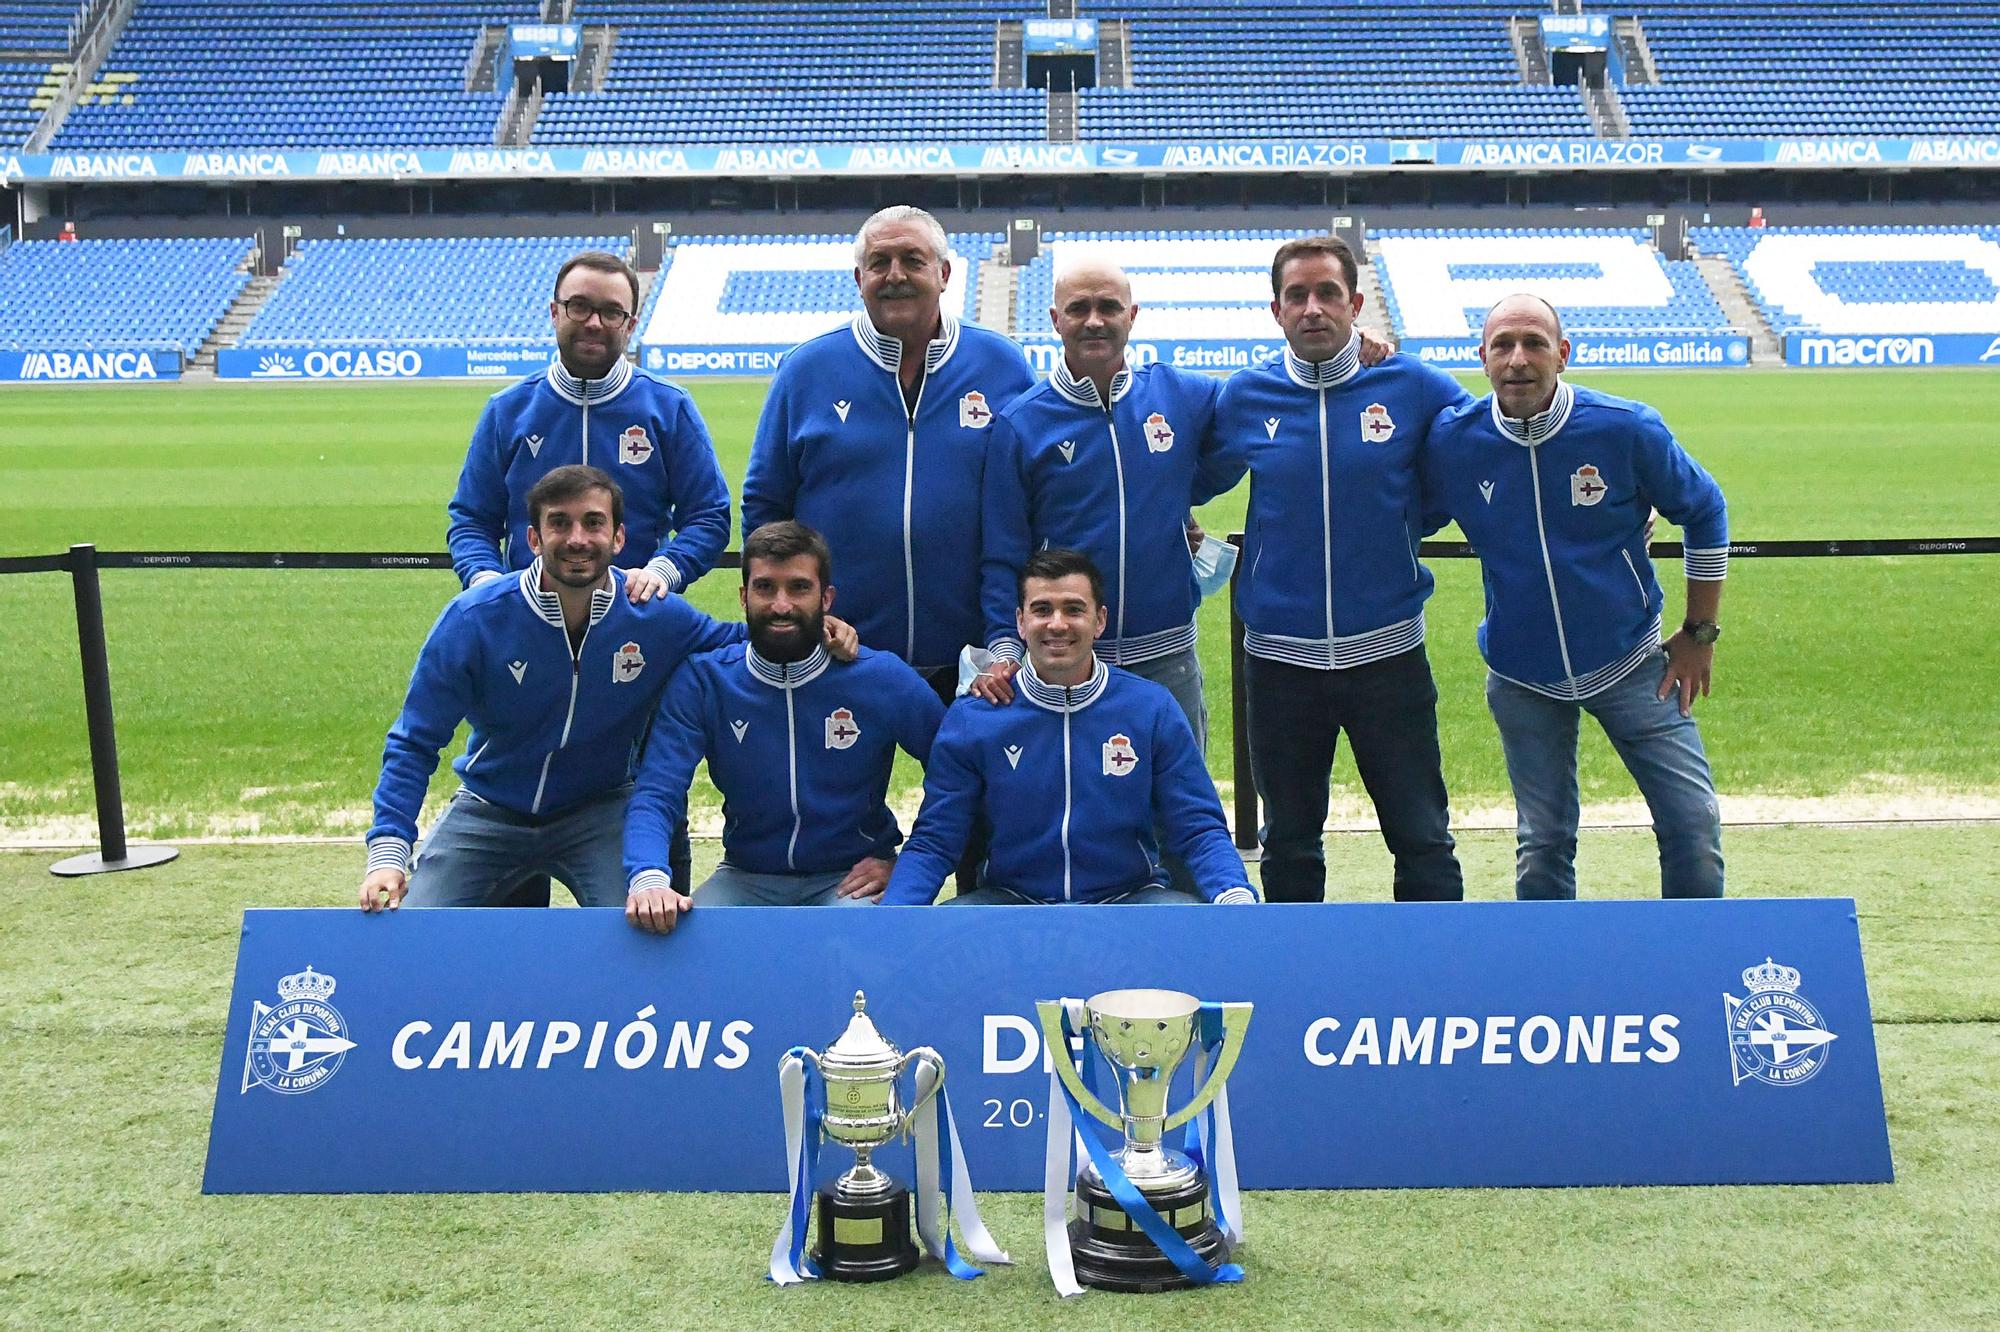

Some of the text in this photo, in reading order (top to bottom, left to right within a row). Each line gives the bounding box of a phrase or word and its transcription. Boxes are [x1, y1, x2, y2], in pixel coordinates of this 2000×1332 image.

[459, 151, 555, 172] ABANCA
[592, 150, 688, 171] ABANCA
[725, 149, 821, 170] ABANCA
[858, 147, 955, 168] ABANCA
[990, 146, 1088, 167] ABANCA
[1172, 144, 1367, 166] ABANCA RIAZOR
[1470, 143, 1663, 164] ABANCA RIAZOR
[1786, 140, 1882, 162] ABANCA
[1917, 140, 2000, 161] ABANC
[61, 155, 157, 177] ABANCA
[193, 153, 290, 176] ABANCA
[326, 153, 423, 175] ABANCA
[667, 352, 781, 370] DEPORTIEN
[1172, 346, 1248, 367] Estrella
[1424, 346, 1480, 362] ABANC
[1574, 341, 1724, 363] Estrella Galicia
[1800, 337, 1934, 365] macron
[33, 352, 157, 378] ABANCA
[303, 350, 422, 377] OCASO
[259, 1003, 341, 1038] REAL CLUB DEPORTIVO
[1736, 995, 1816, 1030] REAL CLUB DEPORTIVO
[391, 1003, 755, 1071] CAMPIÓNS
[1303, 1013, 1682, 1067] CAMPEONES
[278, 1076, 290, 1088] LA
[1769, 1067, 1781, 1080] LA
